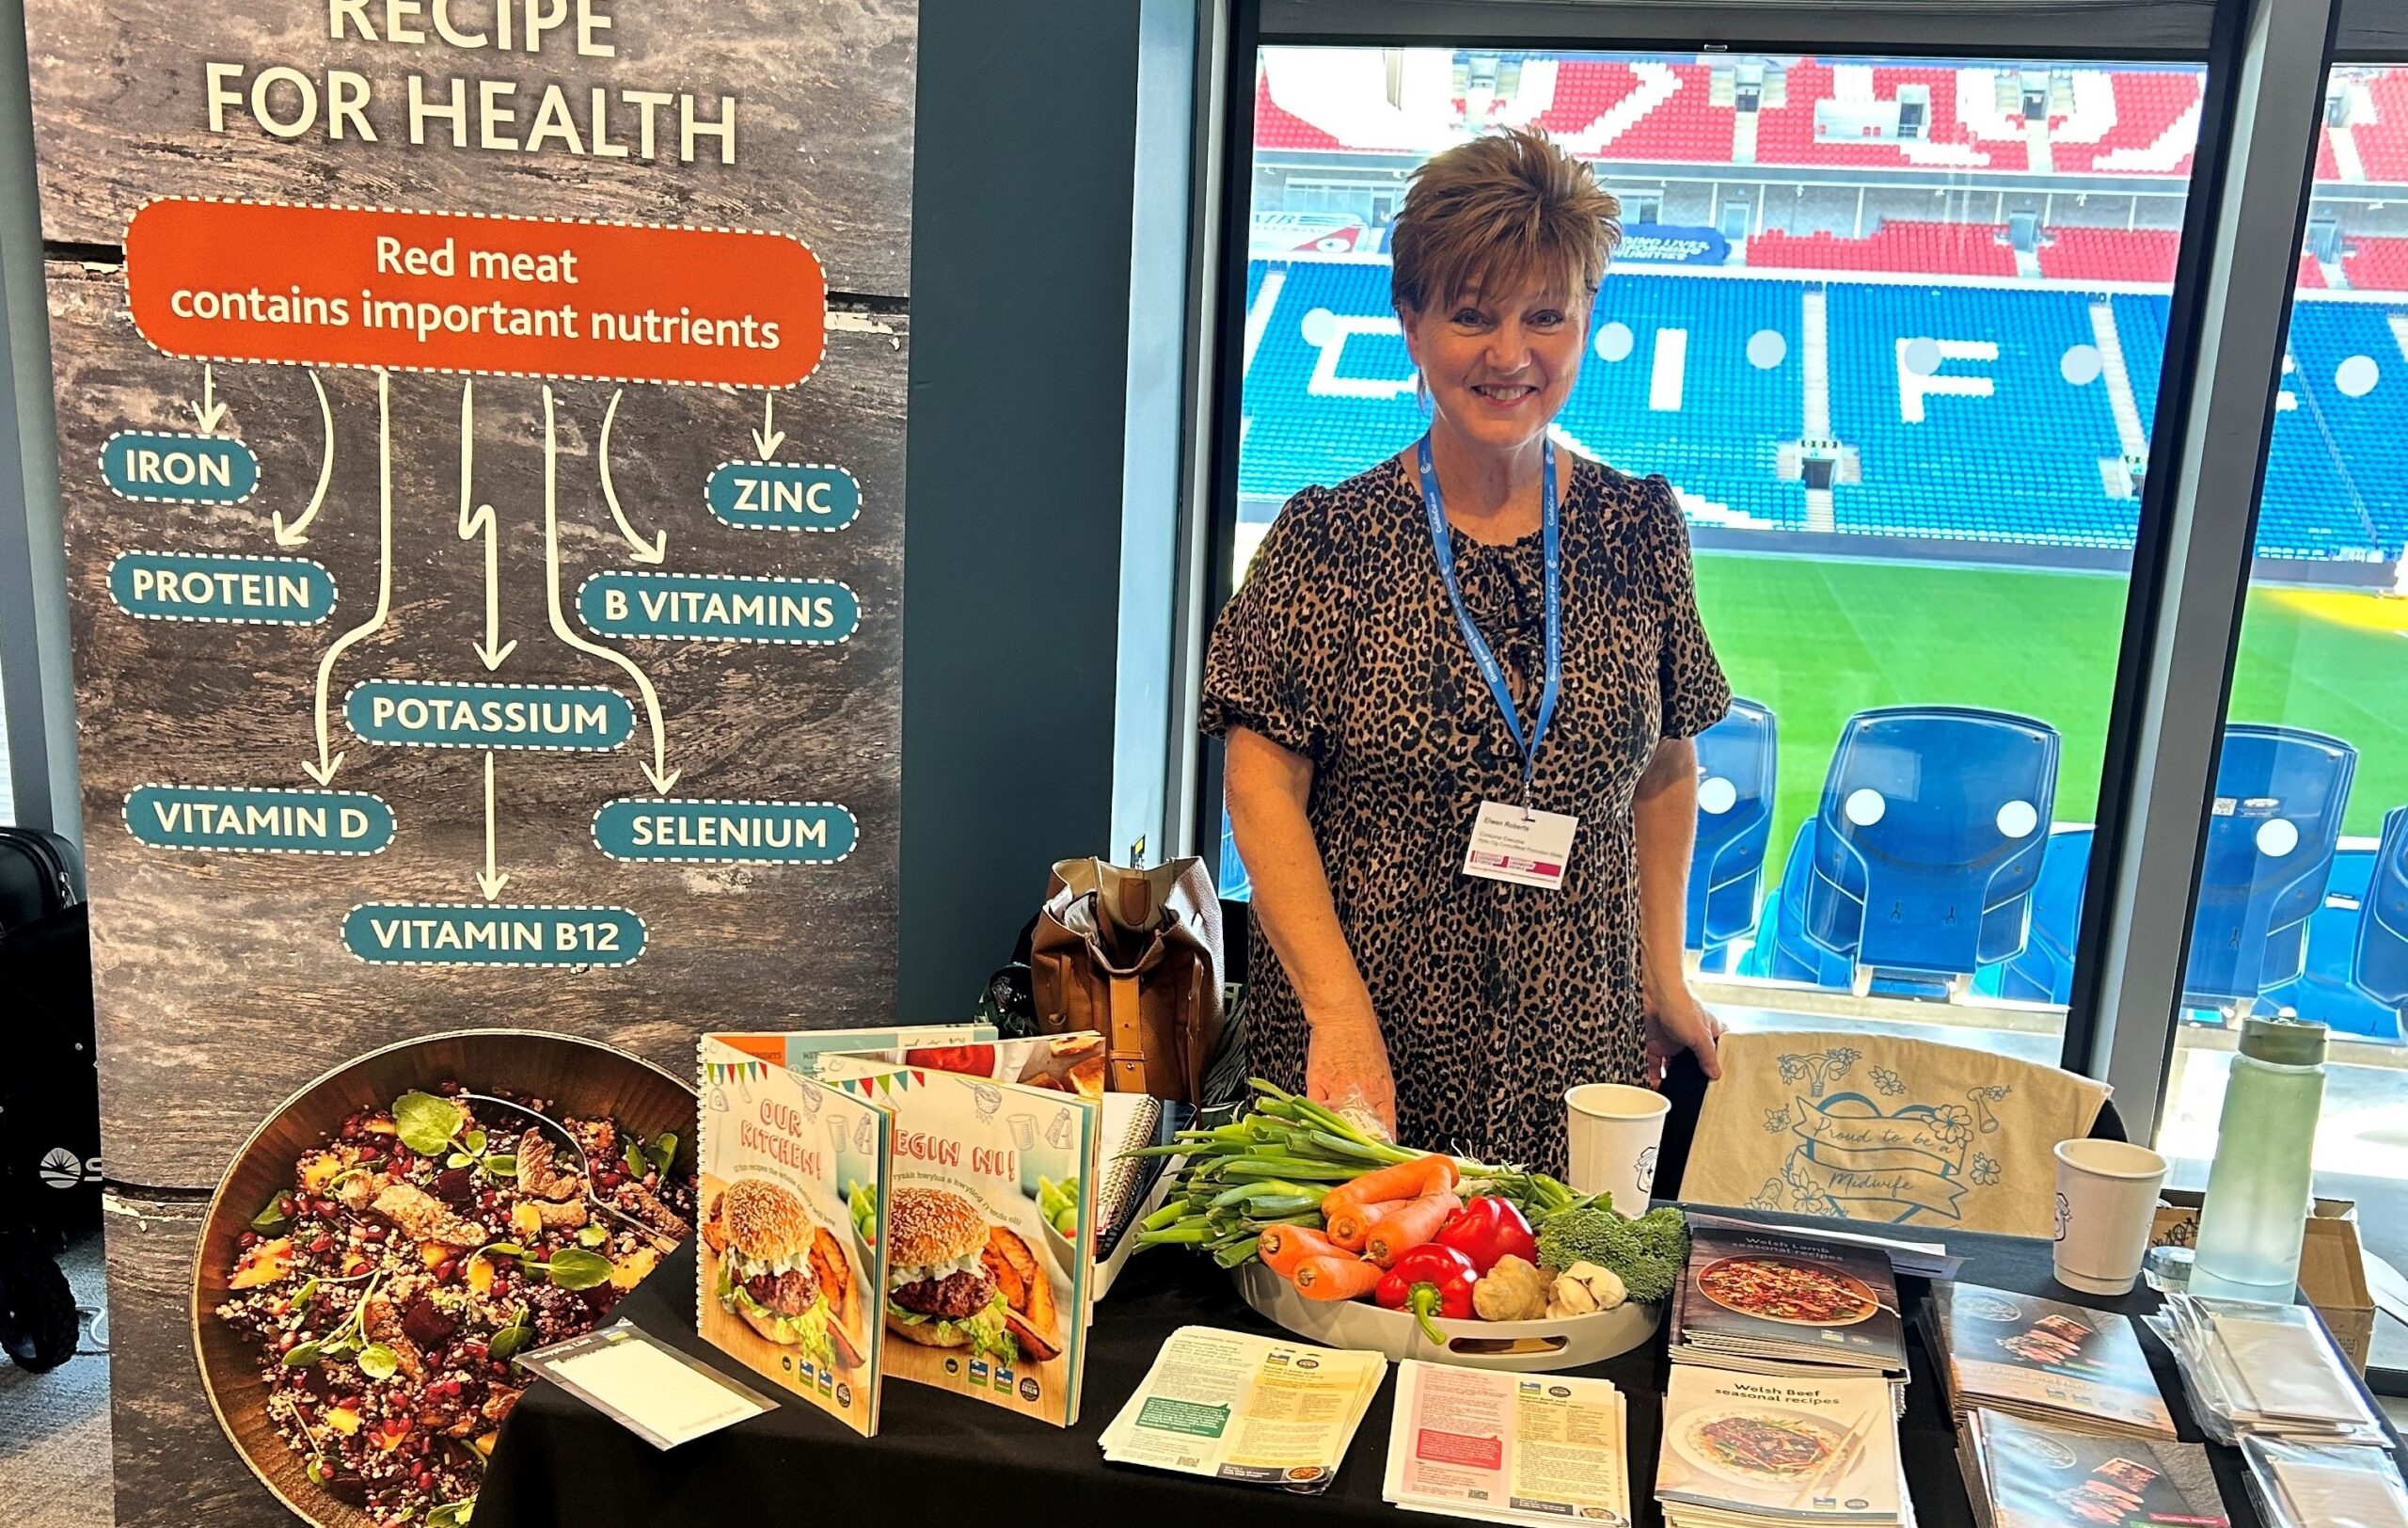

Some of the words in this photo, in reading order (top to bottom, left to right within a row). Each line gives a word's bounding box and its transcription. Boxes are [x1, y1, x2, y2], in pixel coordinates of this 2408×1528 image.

[330, 0, 616, 58] RECIPE
[205, 61, 378, 143] FOR
[408, 74, 737, 166] HEALTH
[376, 235, 462, 279] Red
[468, 247, 578, 285] meat
[170, 285, 350, 328] contains
[361, 290, 580, 342] important
[591, 308, 782, 351] nutrients
[125, 447, 232, 486] IRON
[732, 478, 832, 516] ZINC
[133, 570, 311, 610] PROTEIN
[605, 588, 629, 621] B
[637, 591, 835, 629] VITAMINS
[373, 697, 610, 736] POTASSIUM
[153, 800, 336, 838] VITAMIN
[341, 807, 369, 840] D
[631, 815, 828, 849] SELENIUM
[1504, 820, 1529, 832] Roberts
[371, 919, 549, 952] VITAMIN
[553, 920, 622, 953] B12
[760, 1098, 802, 1138] OUR
[1813, 1117, 1873, 1144] Proud
[1882, 1128, 1904, 1142] to
[1912, 1132, 1934, 1147] be
[1939, 1145, 1954, 1154] a
[740, 1119, 822, 1181] KITCHEN!
[972, 1146, 1015, 1183] NI!
[1828, 1172, 1913, 1199] Midwife
[1731, 1241, 1792, 1255] seasonal
[1794, 1249, 1844, 1262] recipes
[1745, 1235, 1789, 1249] Welsh
[1792, 1242, 1830, 1254] Lamb
[1714, 1388, 1781, 1402] seasonal
[1785, 1395, 1840, 1406] recipes
[1734, 1383, 1782, 1395] Welsh
[1786, 1389, 1821, 1397] Beef
